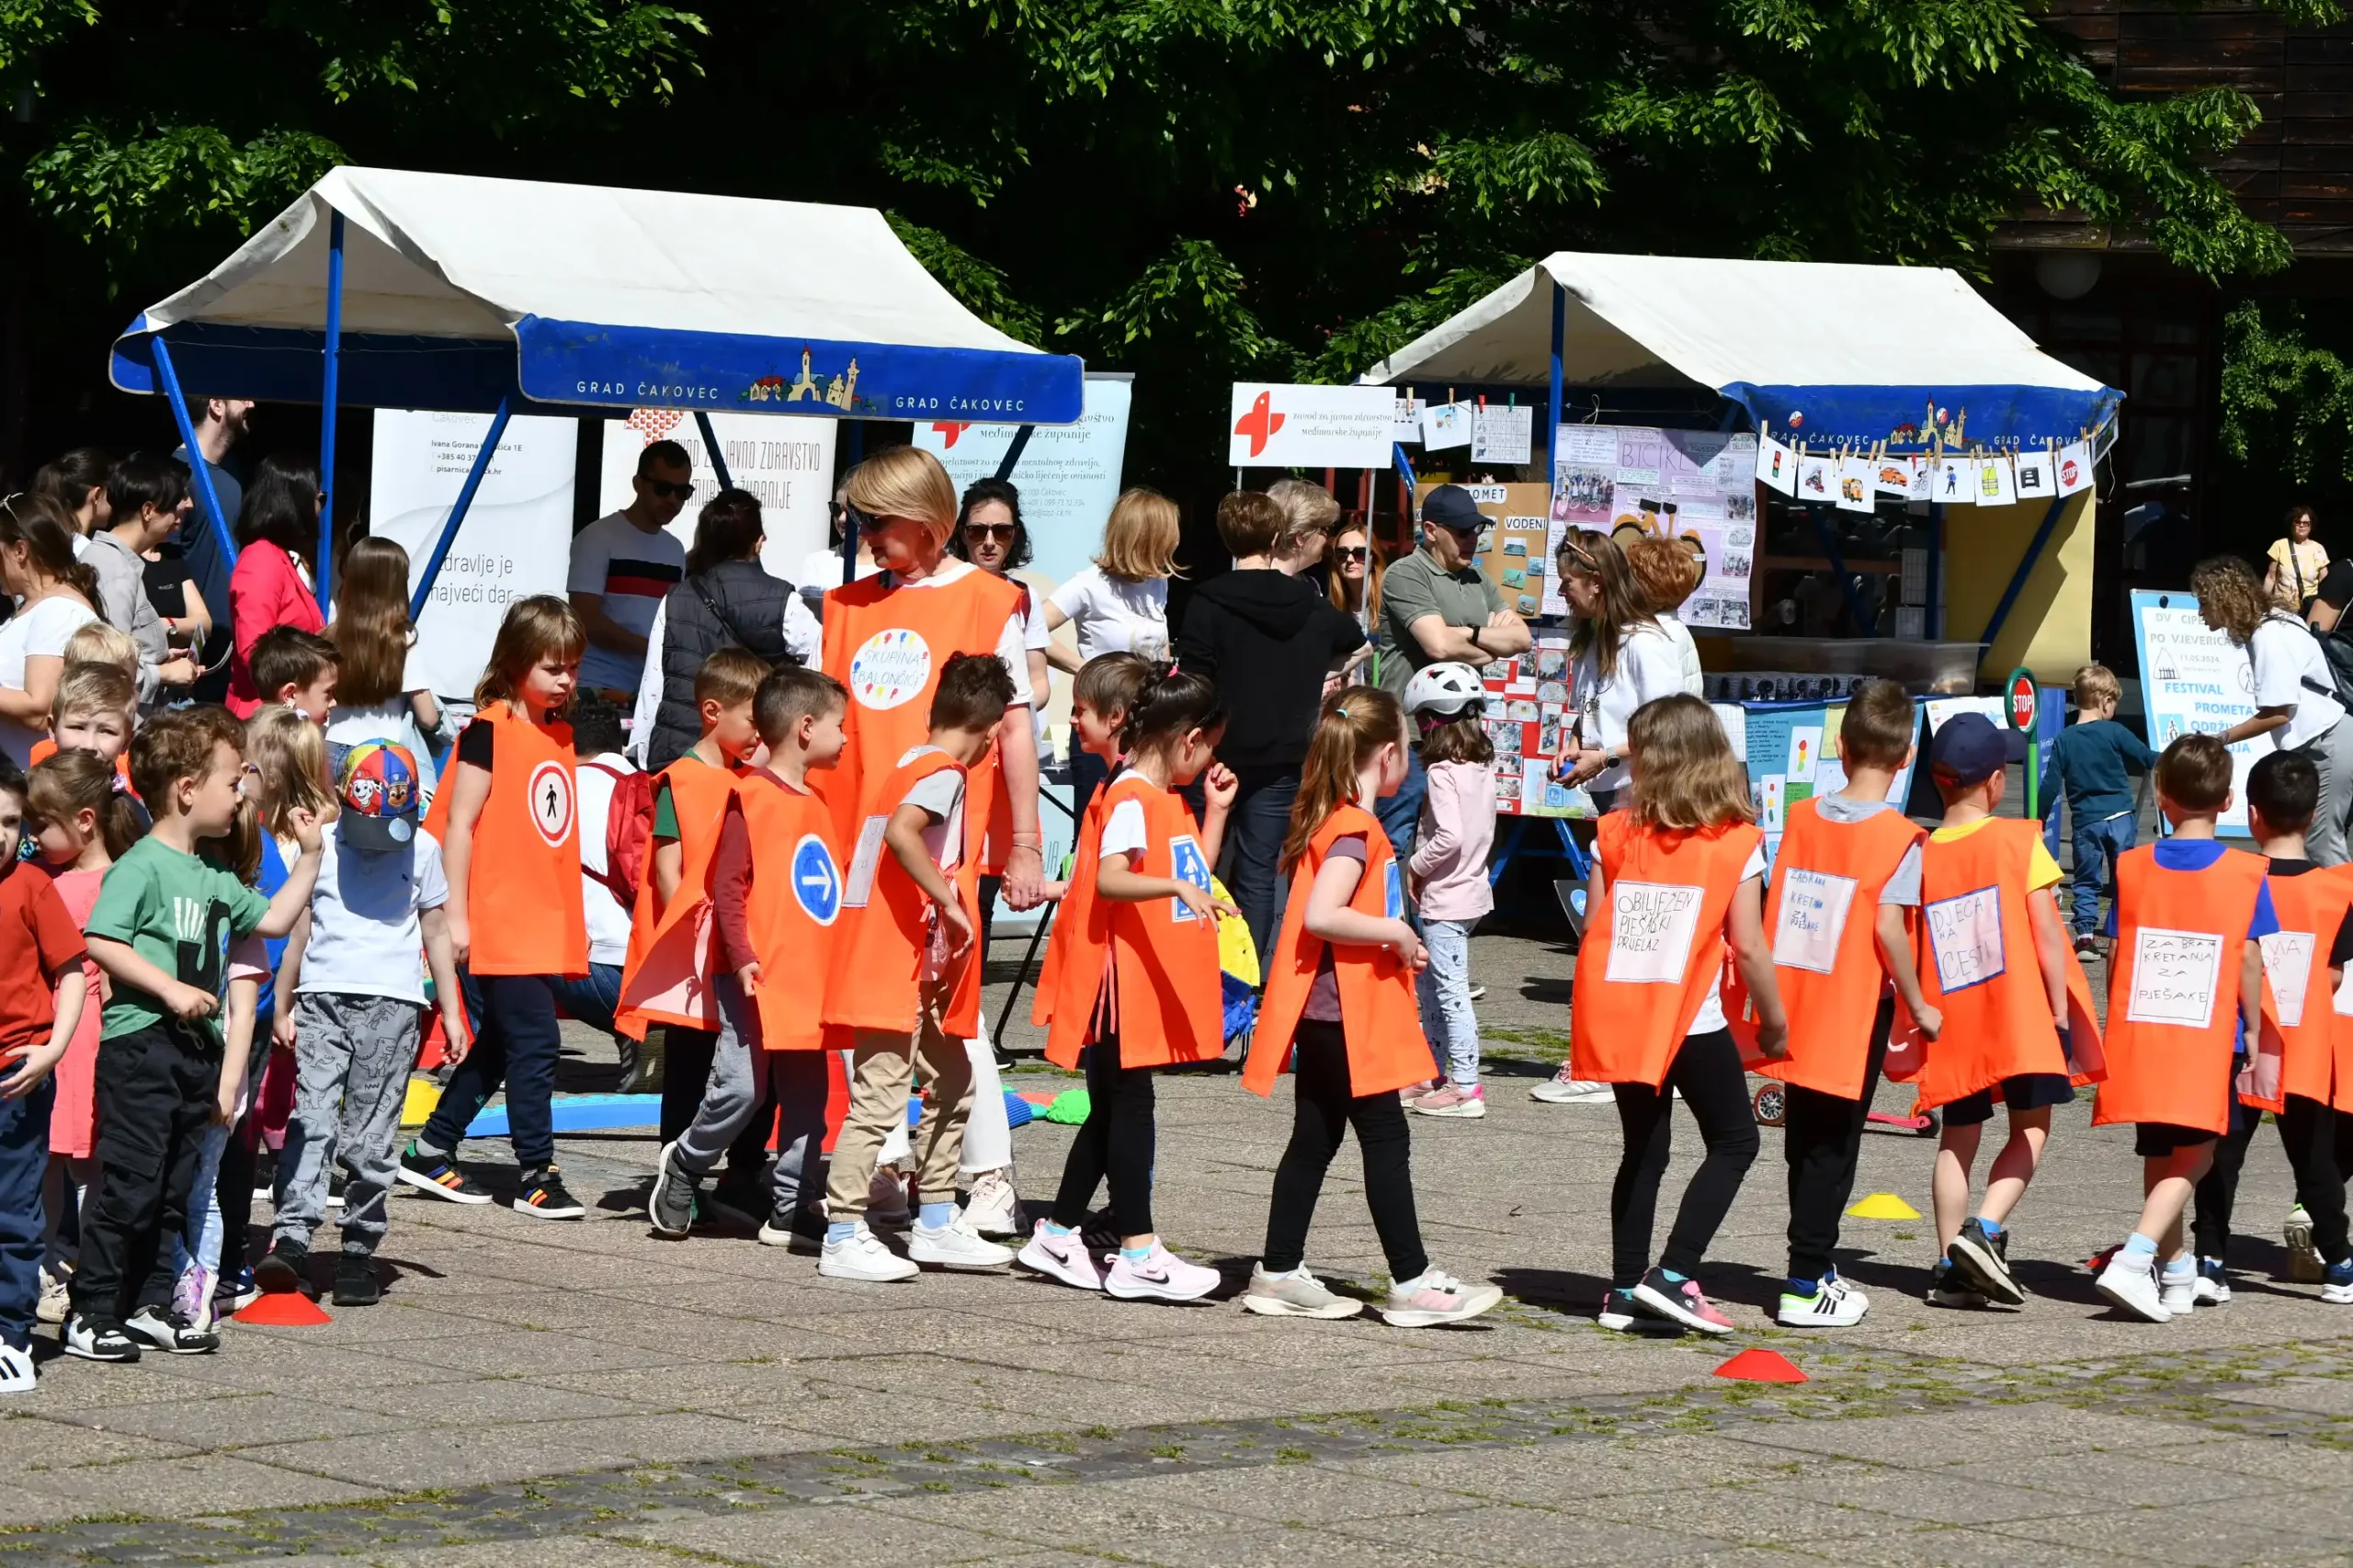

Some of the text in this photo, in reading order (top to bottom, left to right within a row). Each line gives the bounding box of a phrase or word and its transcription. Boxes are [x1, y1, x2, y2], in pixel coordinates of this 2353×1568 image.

[576, 381, 719, 399] GRAD ČAKOVEC
[895, 395, 1025, 411] GRAD ČAKOVEC
[1292, 411, 1392, 424] zavod za javno zdravstvo
[1044, 428, 1091, 443] županije
[1348, 426, 1382, 439] županije
[1770, 431, 1870, 445] RAD ČAKOVEC
[451, 440, 479, 449] Gorana
[437, 452, 455, 460] +385
[456, 453, 466, 461] 40
[760, 441, 821, 472] ZDRAVSTVO
[1021, 458, 1063, 470] mentalnog
[1621, 443, 1692, 472] BICIKL
[2062, 466, 2077, 482] STOP
[1472, 489, 1506, 500] OMET
[498, 555, 513, 577] je
[429, 583, 483, 606] najveći
[2150, 633, 2165, 643] PO
[863, 649, 919, 666] SKUPINA
[2165, 682, 2224, 696] FESTIVAL
[2013, 694, 2033, 713] STOP
[2195, 701, 2254, 716] PROMETA
[1932, 897, 1984, 933] DJECA
[1939, 930, 1957, 940] NA
[2158, 968, 2188, 978] ZA
[2139, 988, 2208, 1004] PJEŠAKE
